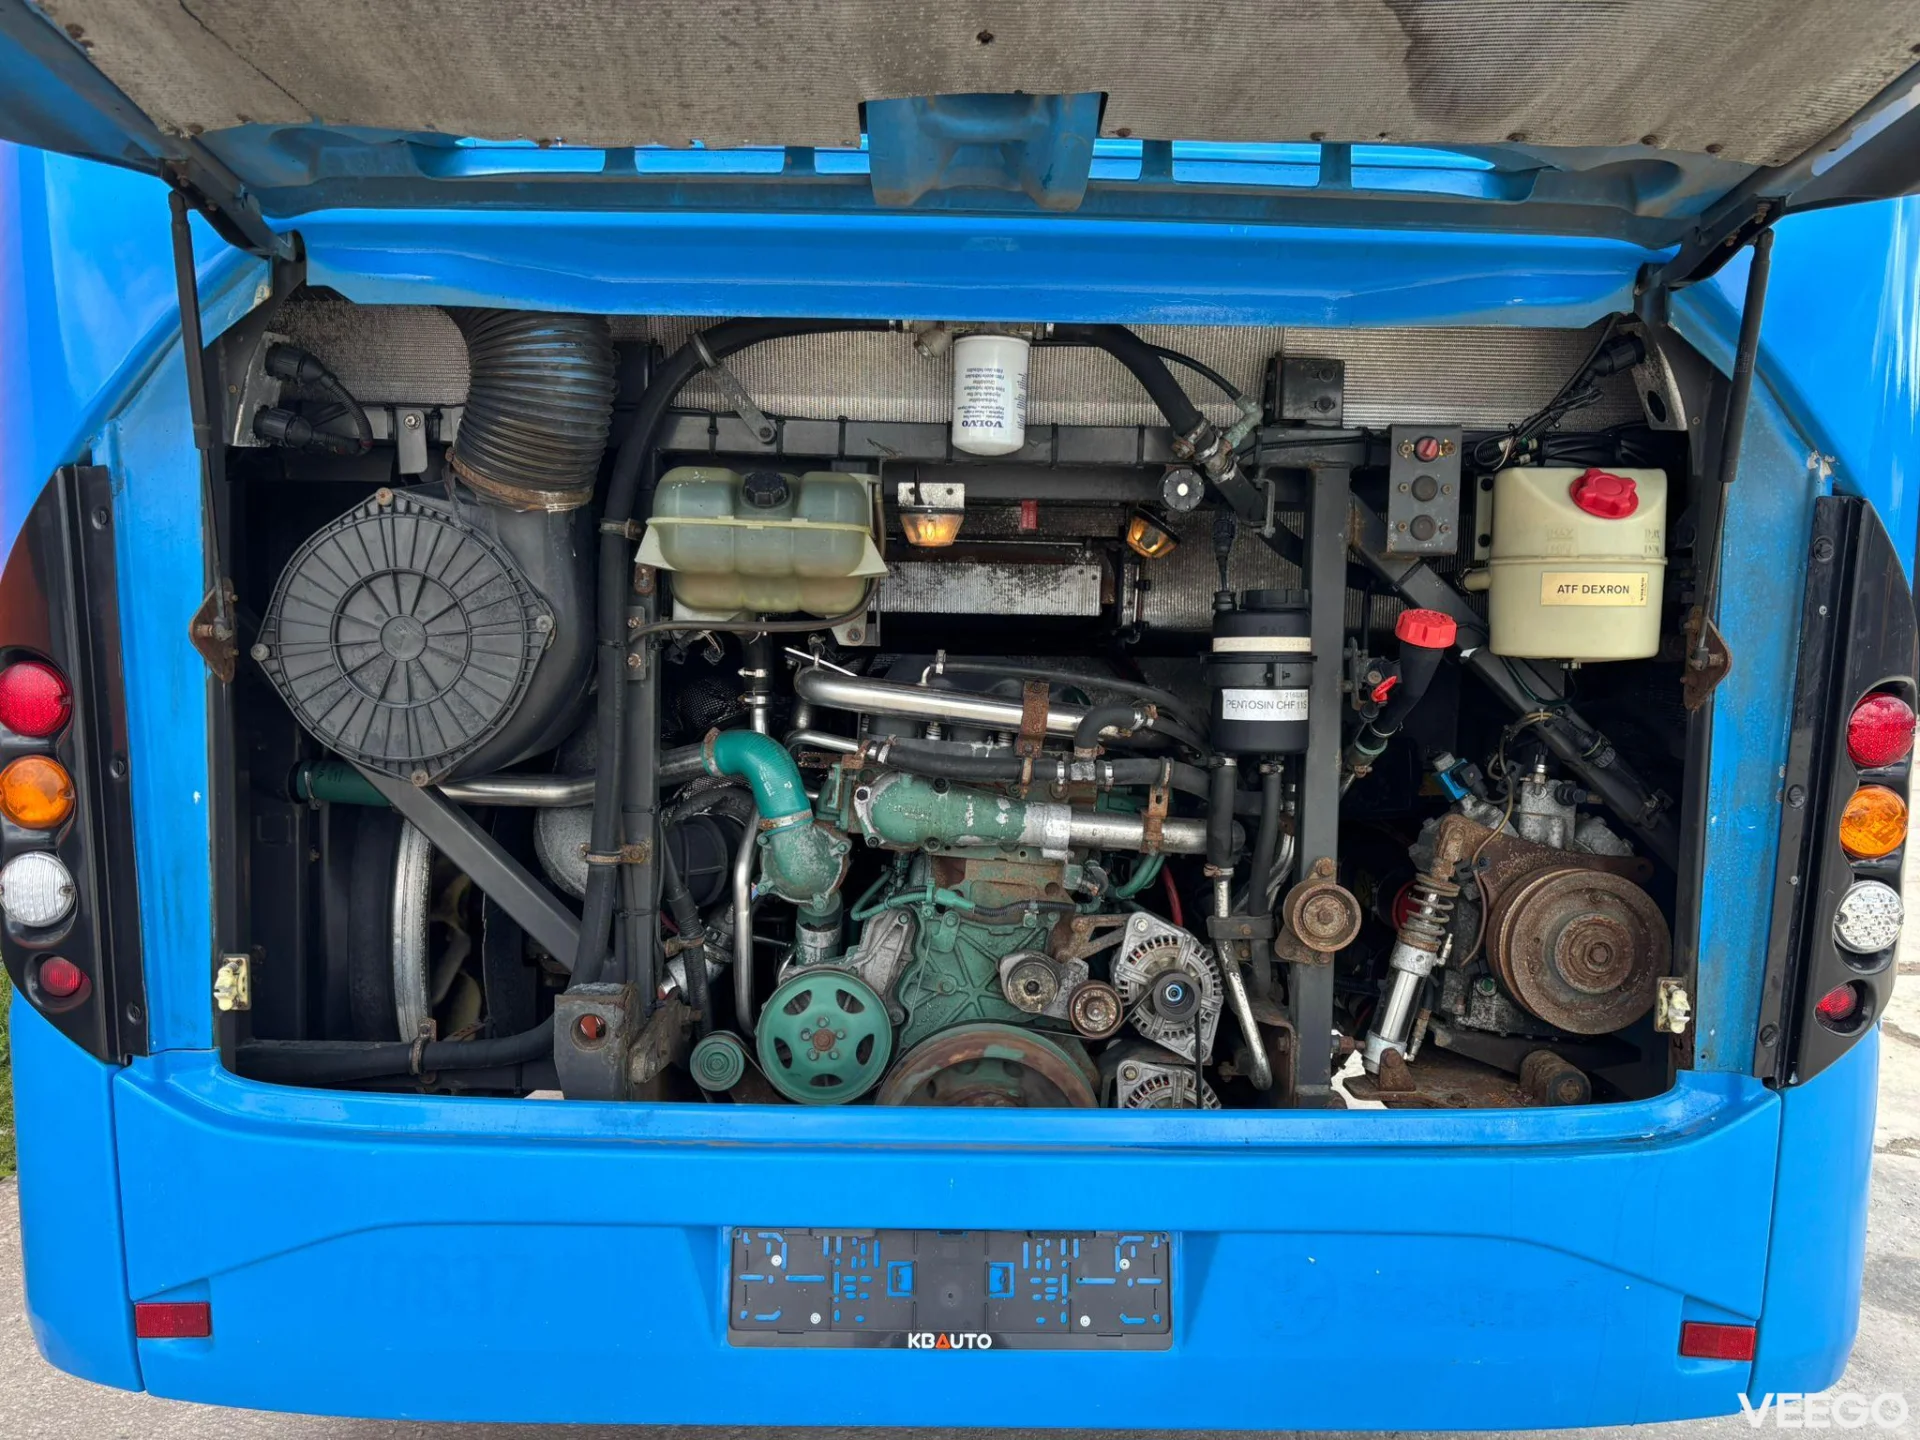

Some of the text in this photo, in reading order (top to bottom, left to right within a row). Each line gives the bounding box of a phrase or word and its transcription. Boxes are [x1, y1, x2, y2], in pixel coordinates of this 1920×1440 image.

[962, 420, 1003, 428] VOLVO
[1557, 584, 1578, 594] ATF
[1581, 584, 1630, 594] DEXRON
[1226, 700, 1274, 710] PENTOSIN
[1276, 700, 1295, 710] CHF
[907, 1332, 992, 1349] KBAUTO
